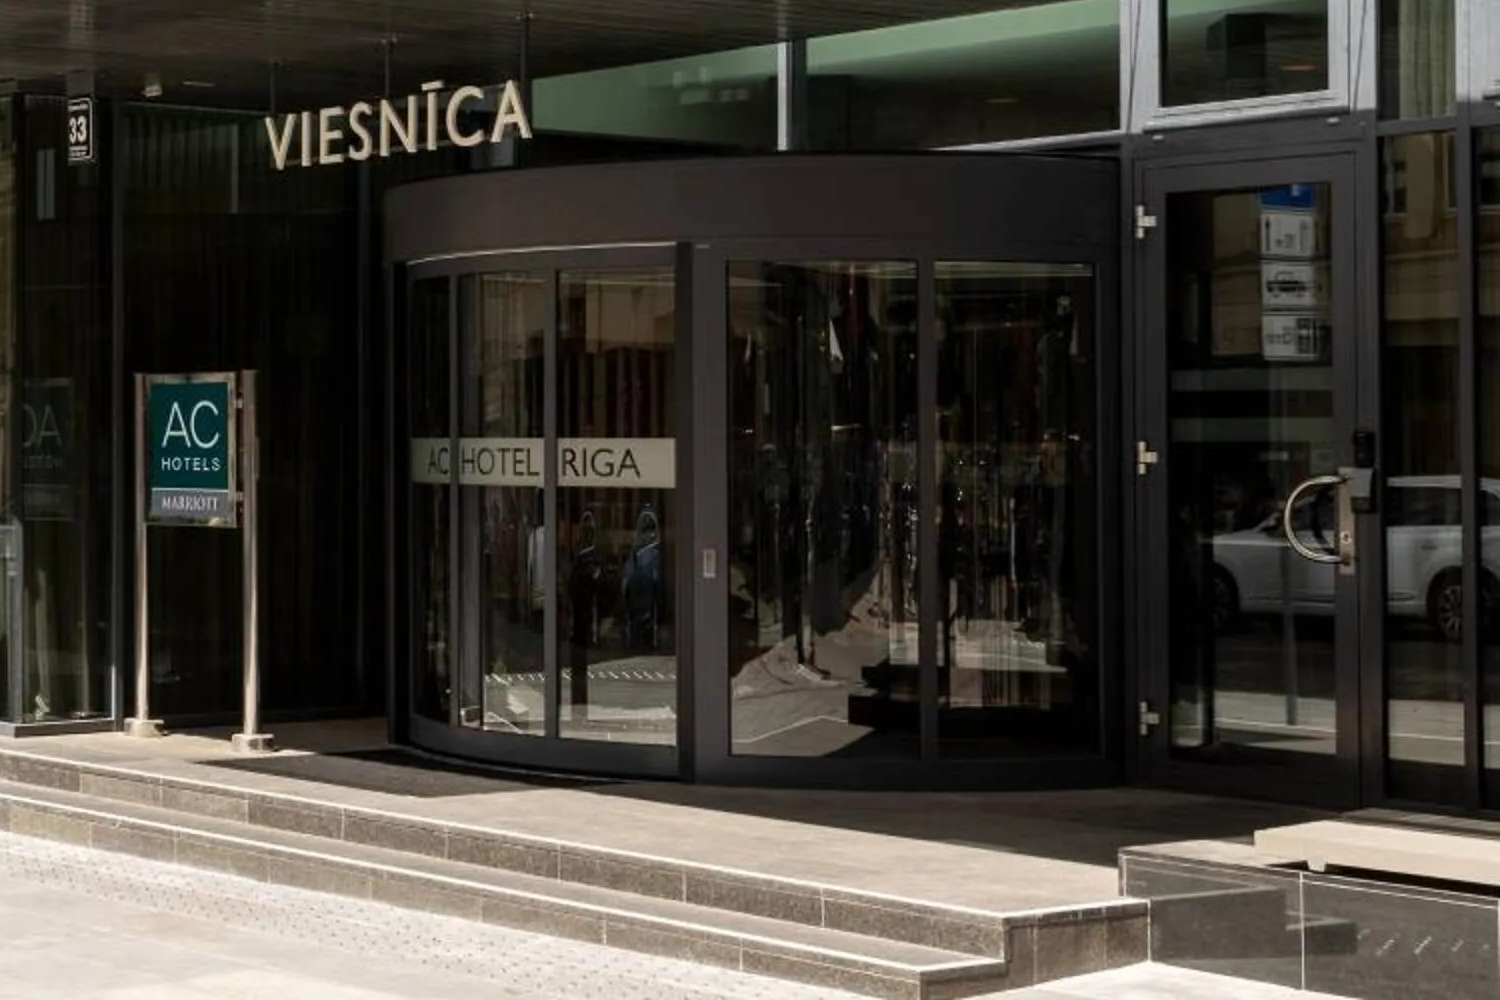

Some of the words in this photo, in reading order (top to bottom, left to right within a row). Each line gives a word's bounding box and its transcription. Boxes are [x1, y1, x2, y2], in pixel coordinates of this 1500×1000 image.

[68, 115, 87, 145] 33
[264, 79, 533, 171] VIESNĪCA
[161, 400, 220, 449] AC
[161, 457, 221, 472] HOTELS
[428, 447, 449, 475] AC
[461, 447, 540, 477] HOTEL
[561, 447, 641, 478] RIGA
[161, 495, 219, 511] MARRIOTT
